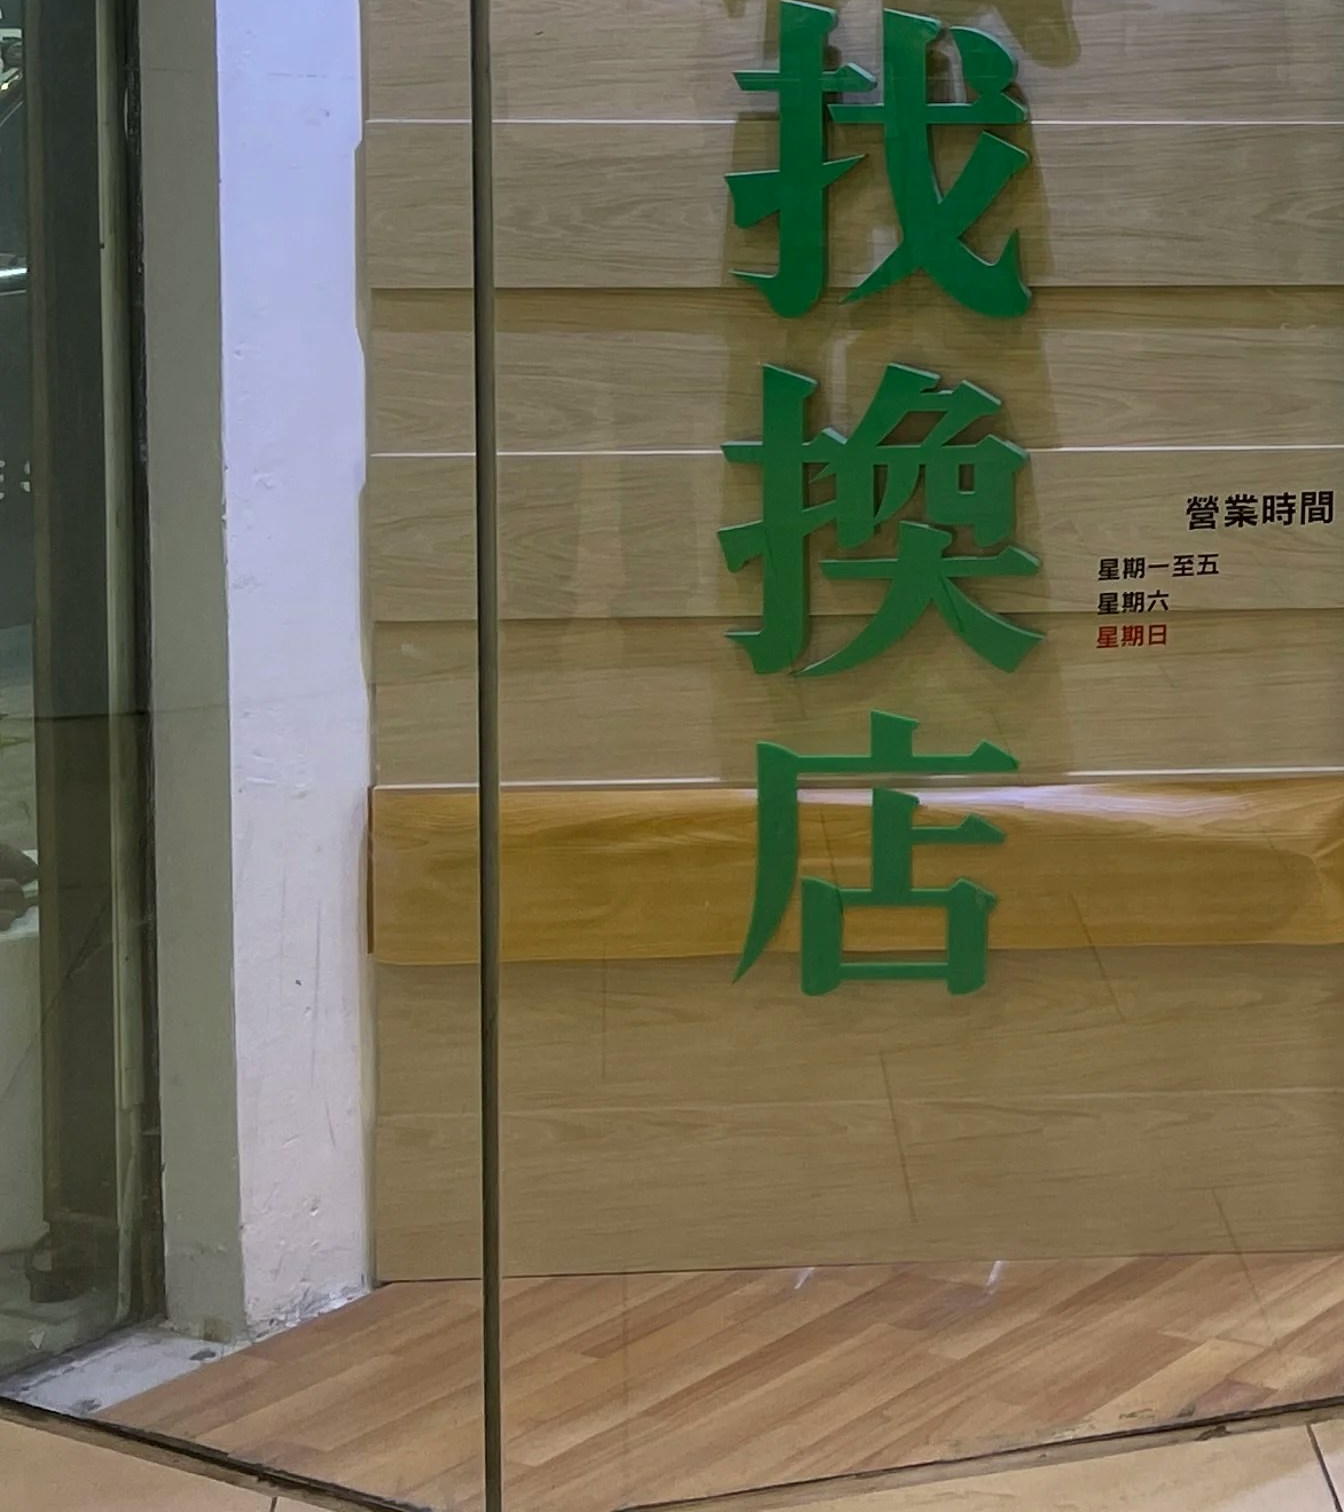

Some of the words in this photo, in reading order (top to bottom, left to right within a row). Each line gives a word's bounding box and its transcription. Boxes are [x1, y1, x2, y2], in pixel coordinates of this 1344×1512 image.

[1186, 491, 1334, 530] 營業時間
[1097, 553, 1219, 581] 星期一至五
[1096, 590, 1169, 615] 星期六
[1096, 624, 1167, 648] 星期日
